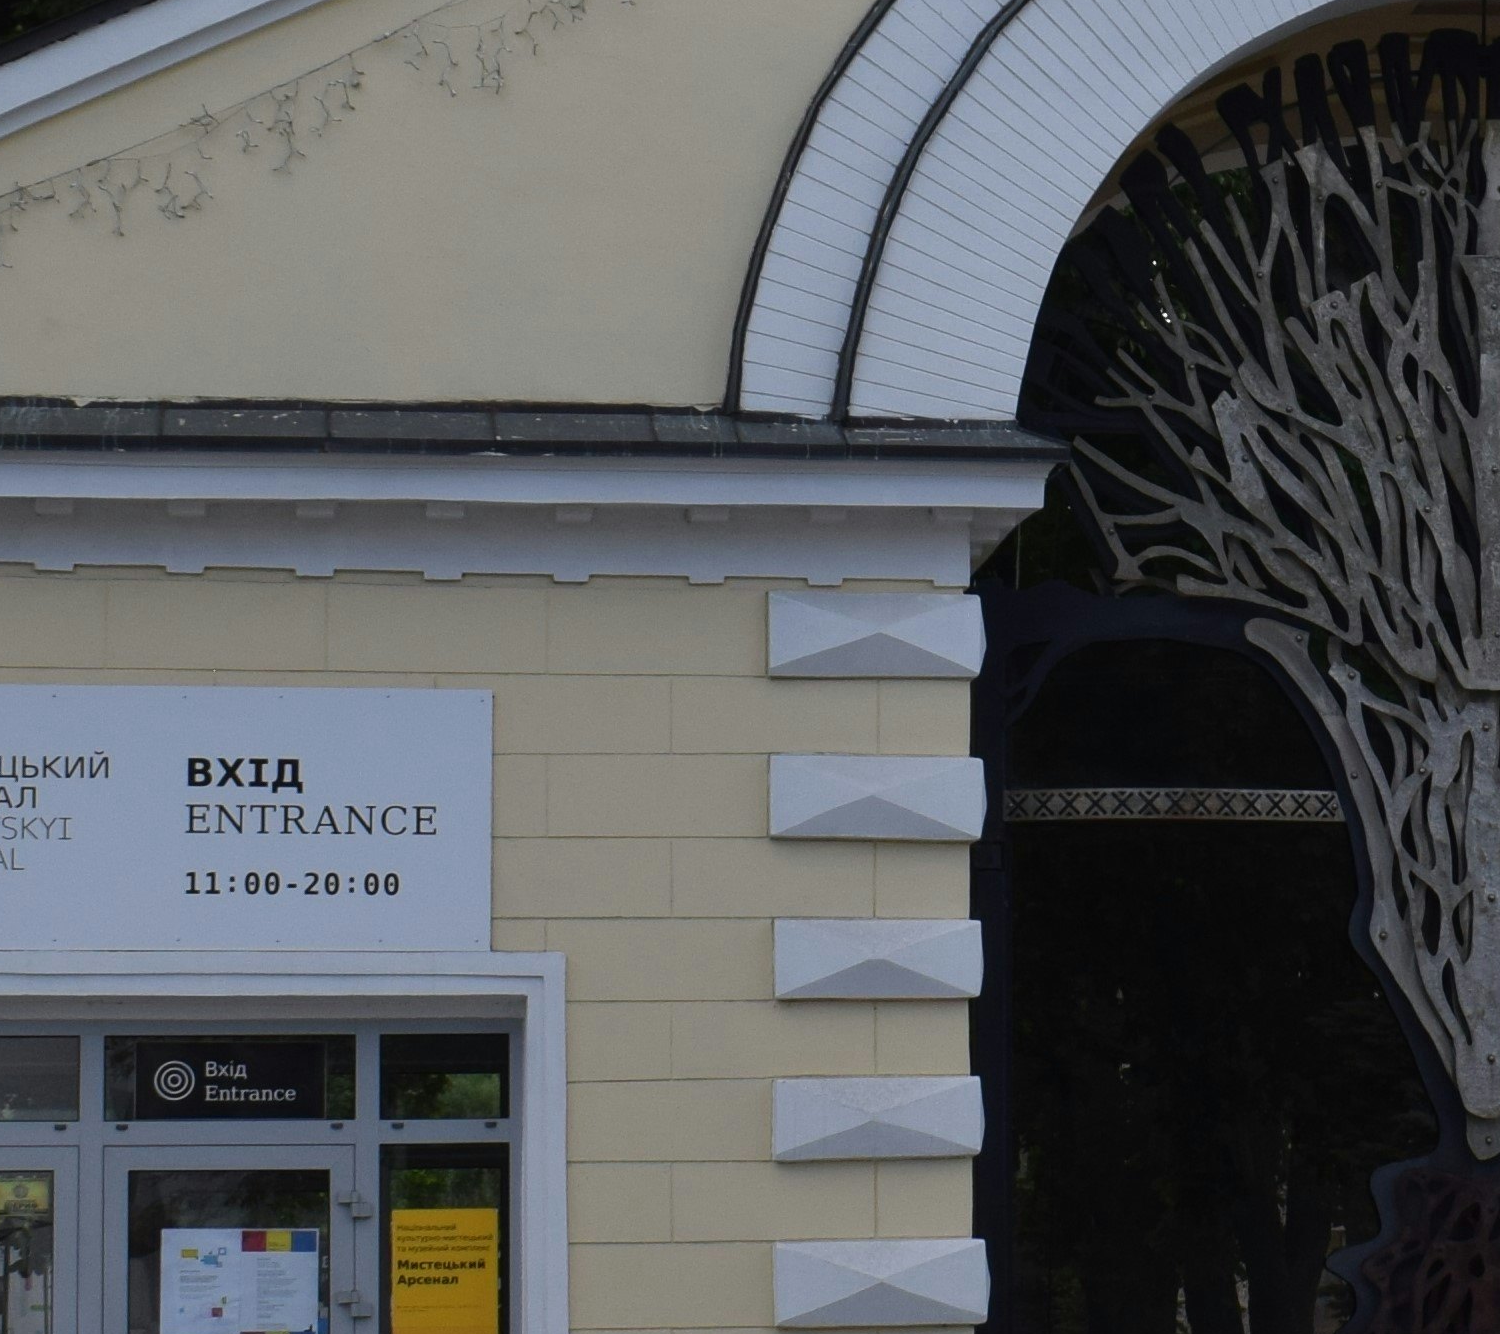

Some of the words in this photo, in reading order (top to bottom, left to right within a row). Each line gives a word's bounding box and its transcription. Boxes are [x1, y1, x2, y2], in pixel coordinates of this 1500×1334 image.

[186, 757, 303, 793] ВХІД
[185, 803, 438, 837] ENTRANCE
[185, 871, 401, 897] 11:00-20:00
[205, 1060, 248, 1079] Вхід
[205, 1085, 297, 1102] Entrance
[397, 1258, 486, 1271] Мистецький
[397, 1274, 459, 1287] Арсенал
